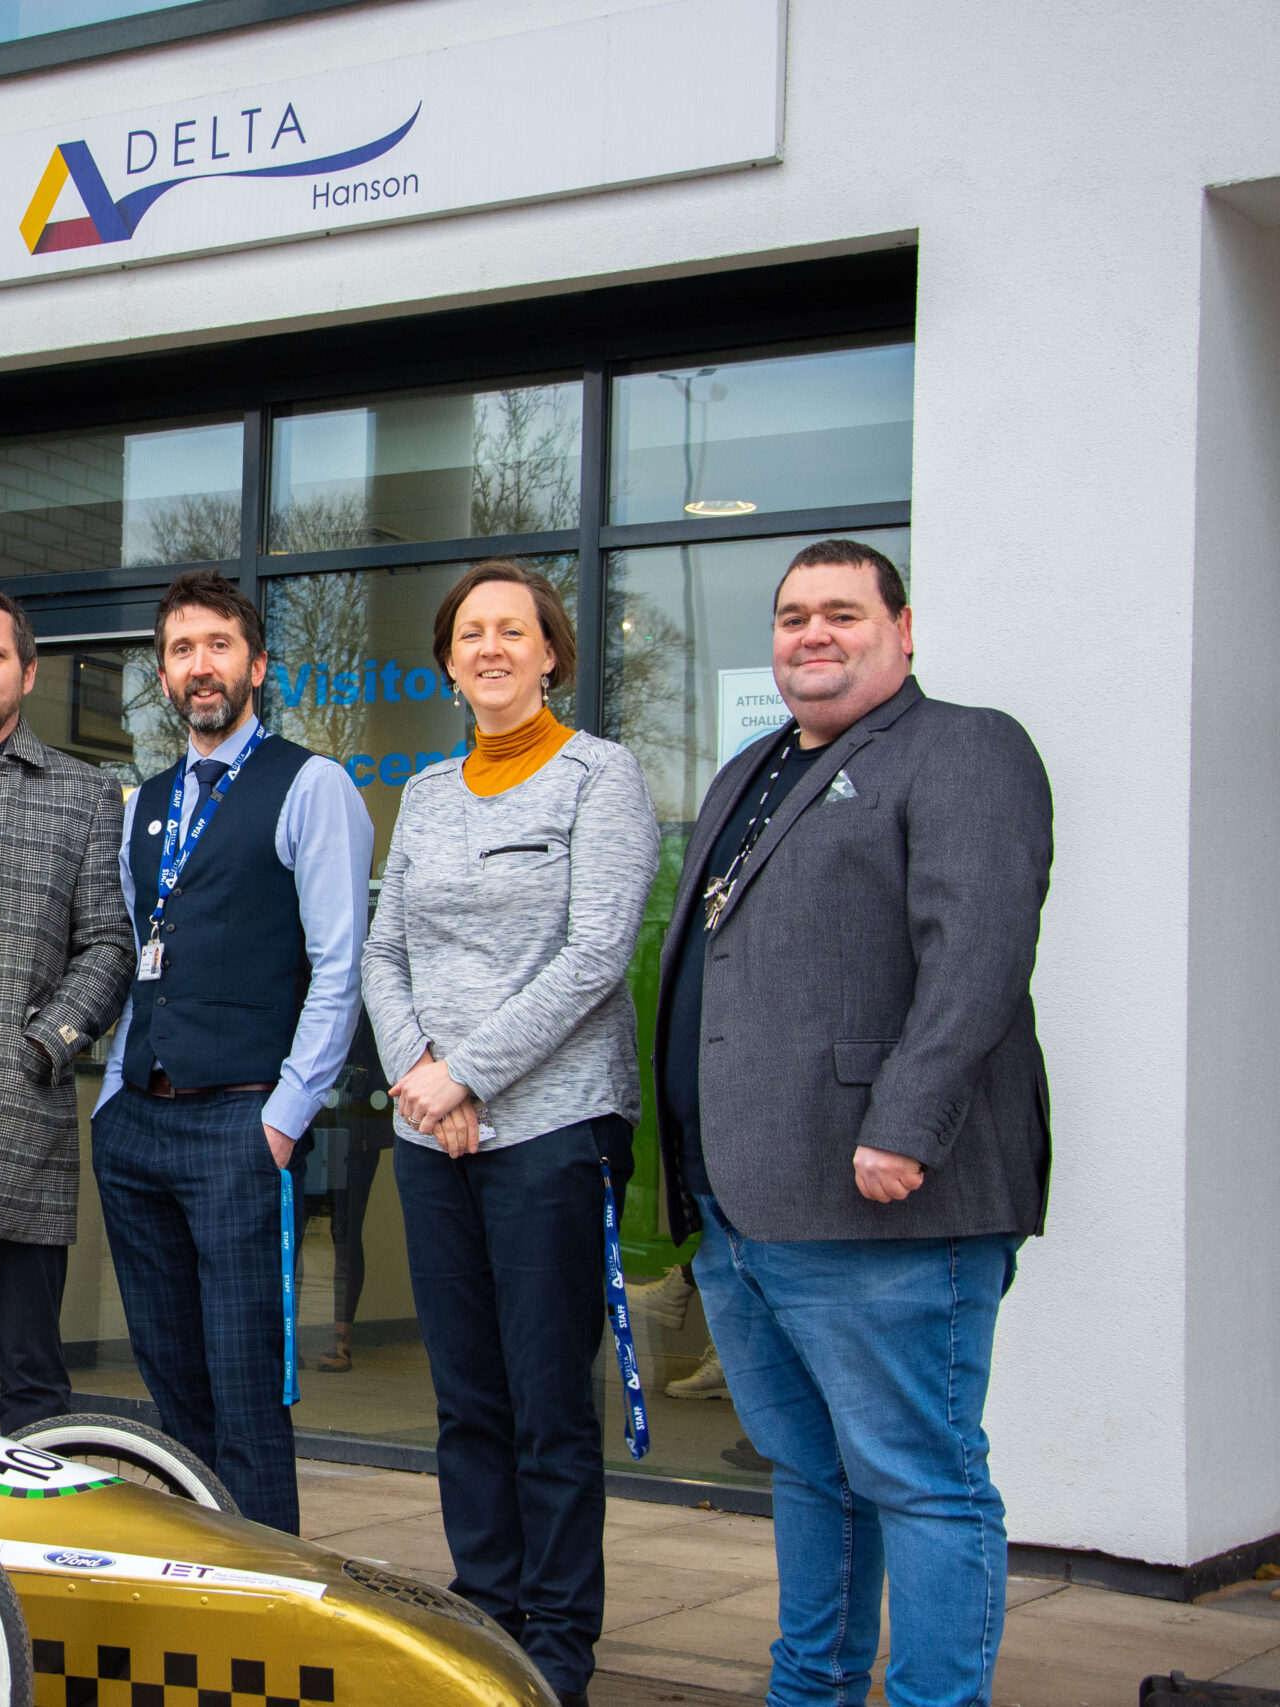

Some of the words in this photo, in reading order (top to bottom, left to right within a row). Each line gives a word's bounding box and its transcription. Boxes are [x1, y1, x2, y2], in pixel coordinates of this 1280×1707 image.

[126, 102, 306, 175] DELTA
[313, 173, 418, 210] Hanson
[173, 789, 183, 808] STAFF
[191, 818, 206, 839] STAFF
[606, 1205, 614, 1228] STAFF
[618, 1304, 628, 1329] STAFF
[633, 1406, 645, 1431] STAFF
[56, 1552, 101, 1568] Ford
[161, 1562, 214, 1579] IET
